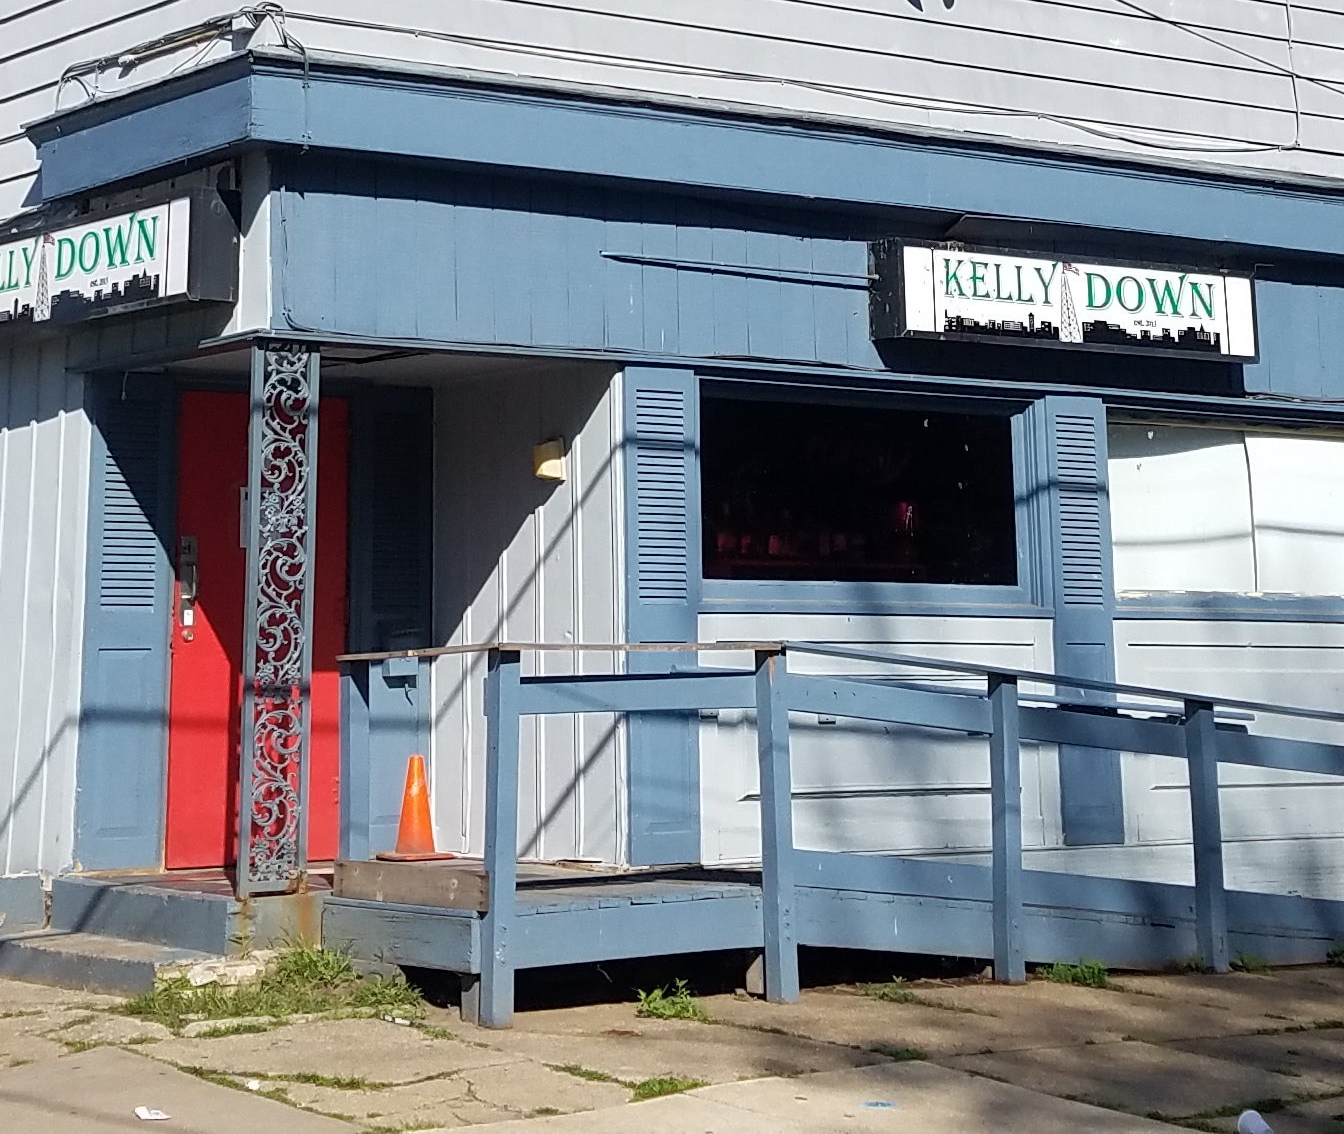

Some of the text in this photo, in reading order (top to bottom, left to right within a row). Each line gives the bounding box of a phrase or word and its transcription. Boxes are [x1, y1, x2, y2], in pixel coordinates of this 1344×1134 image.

[55, 212, 160, 280] DOWN
[943, 258, 1216, 320] KELLY DOWN
